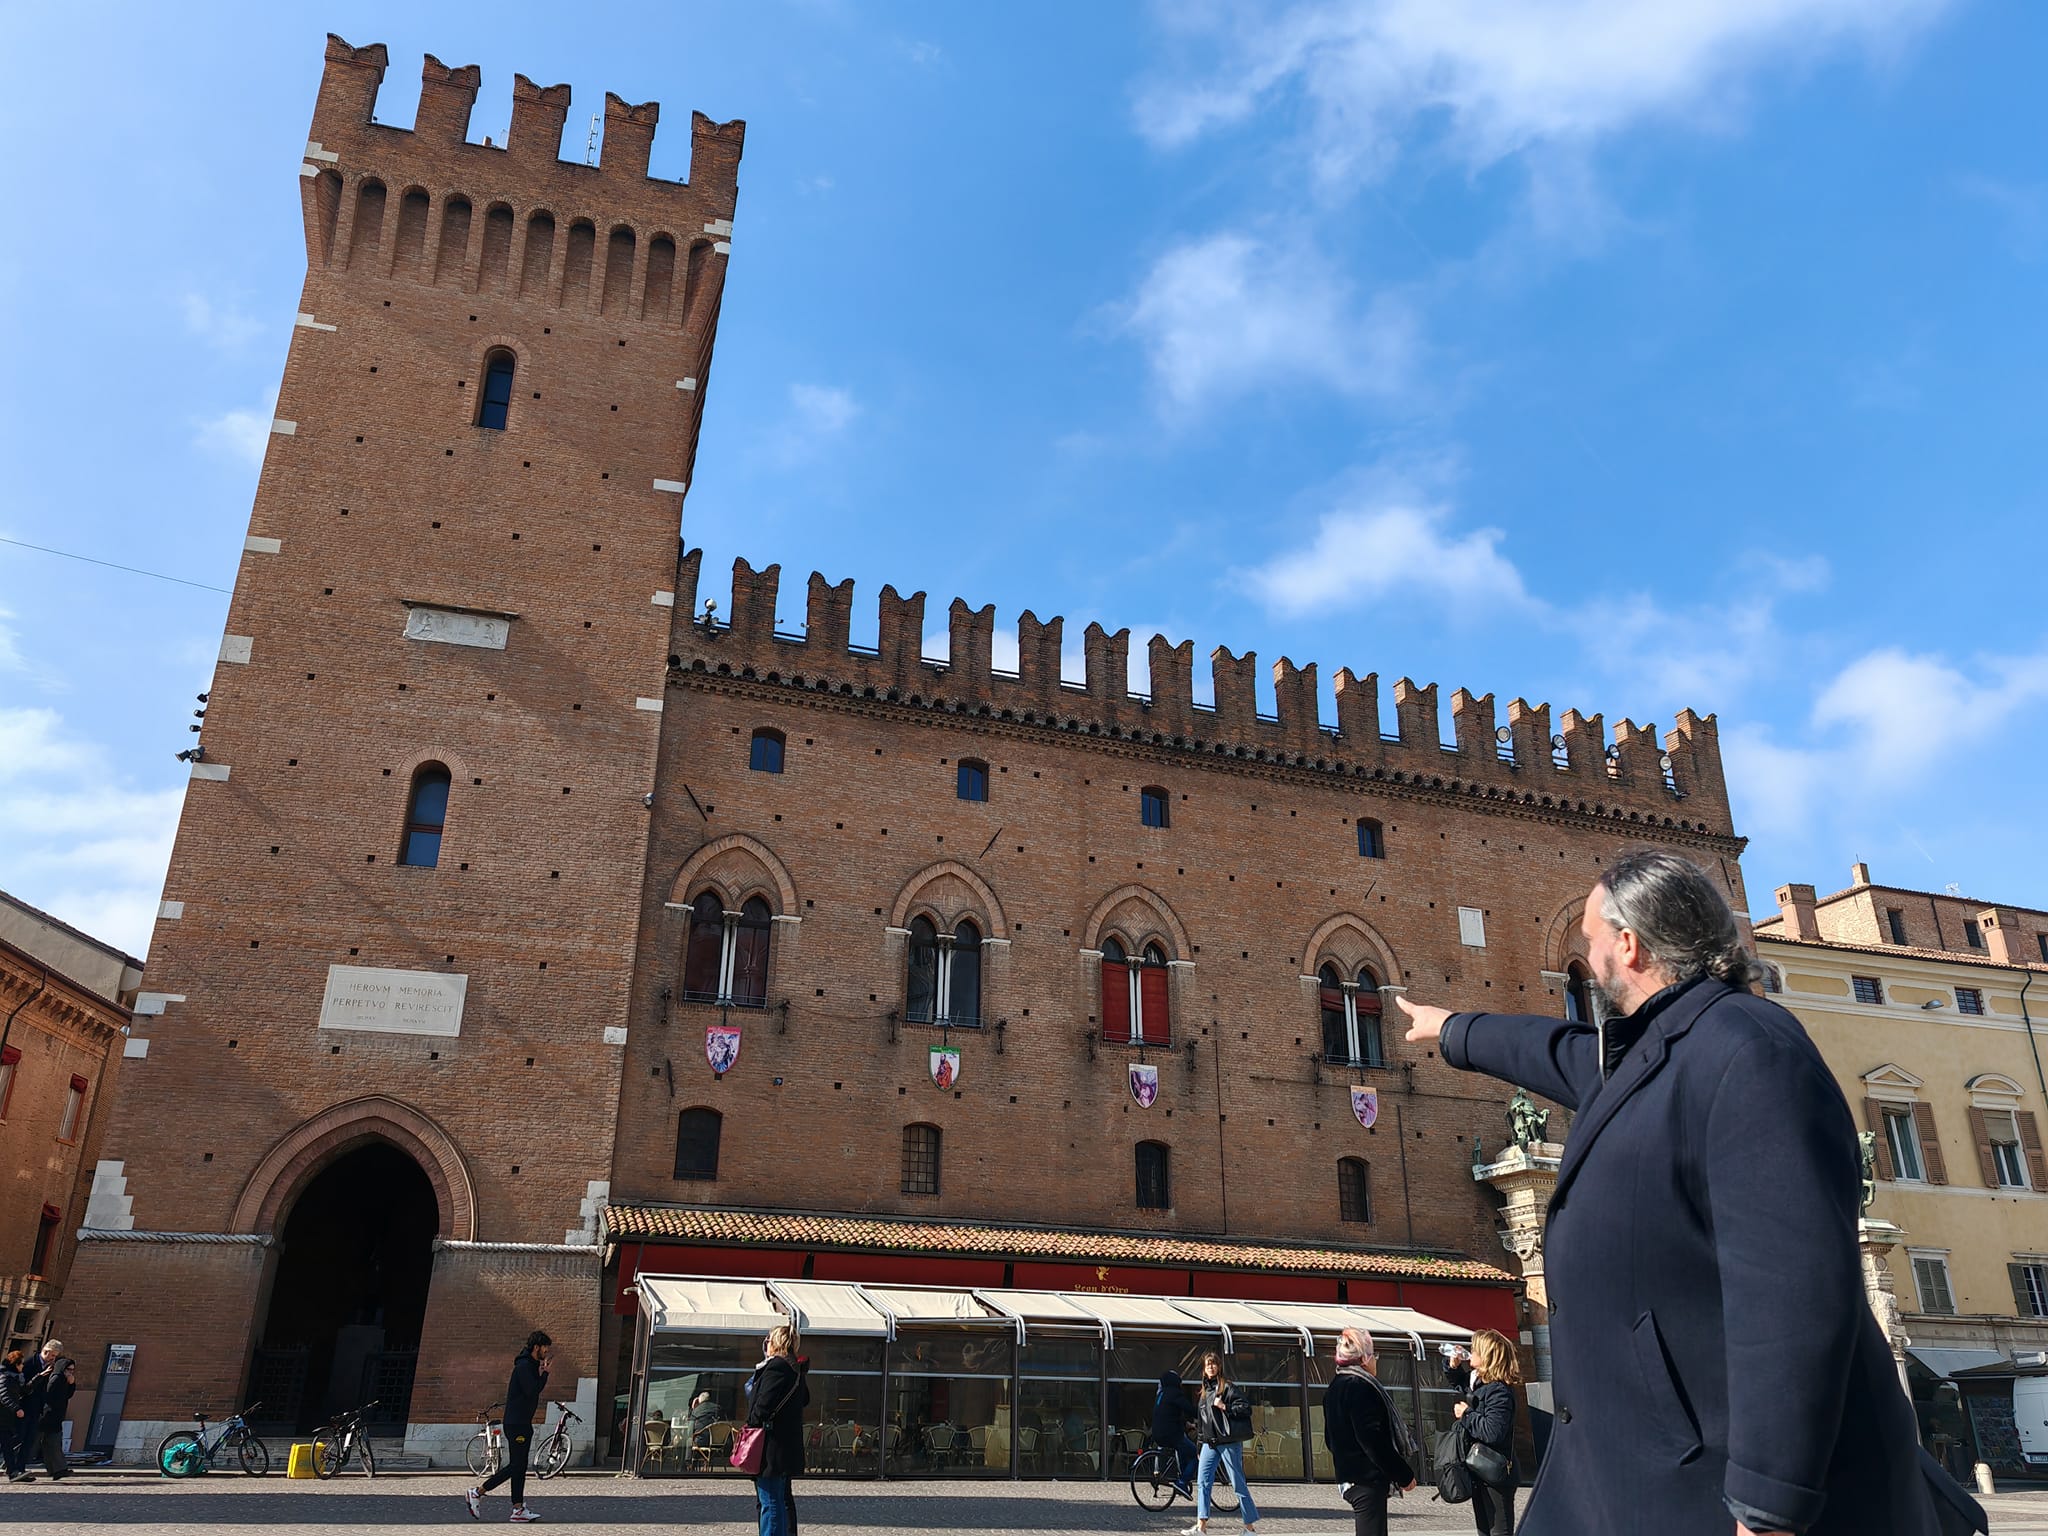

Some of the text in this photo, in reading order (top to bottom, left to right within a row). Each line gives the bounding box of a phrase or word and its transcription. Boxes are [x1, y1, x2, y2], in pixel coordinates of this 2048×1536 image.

[349, 983, 443, 997] HEROVM MEMORIA
[332, 998, 454, 1014] PERPETVO REVIRESCIT
[1074, 1283, 1129, 1294] Leon d'Oro
